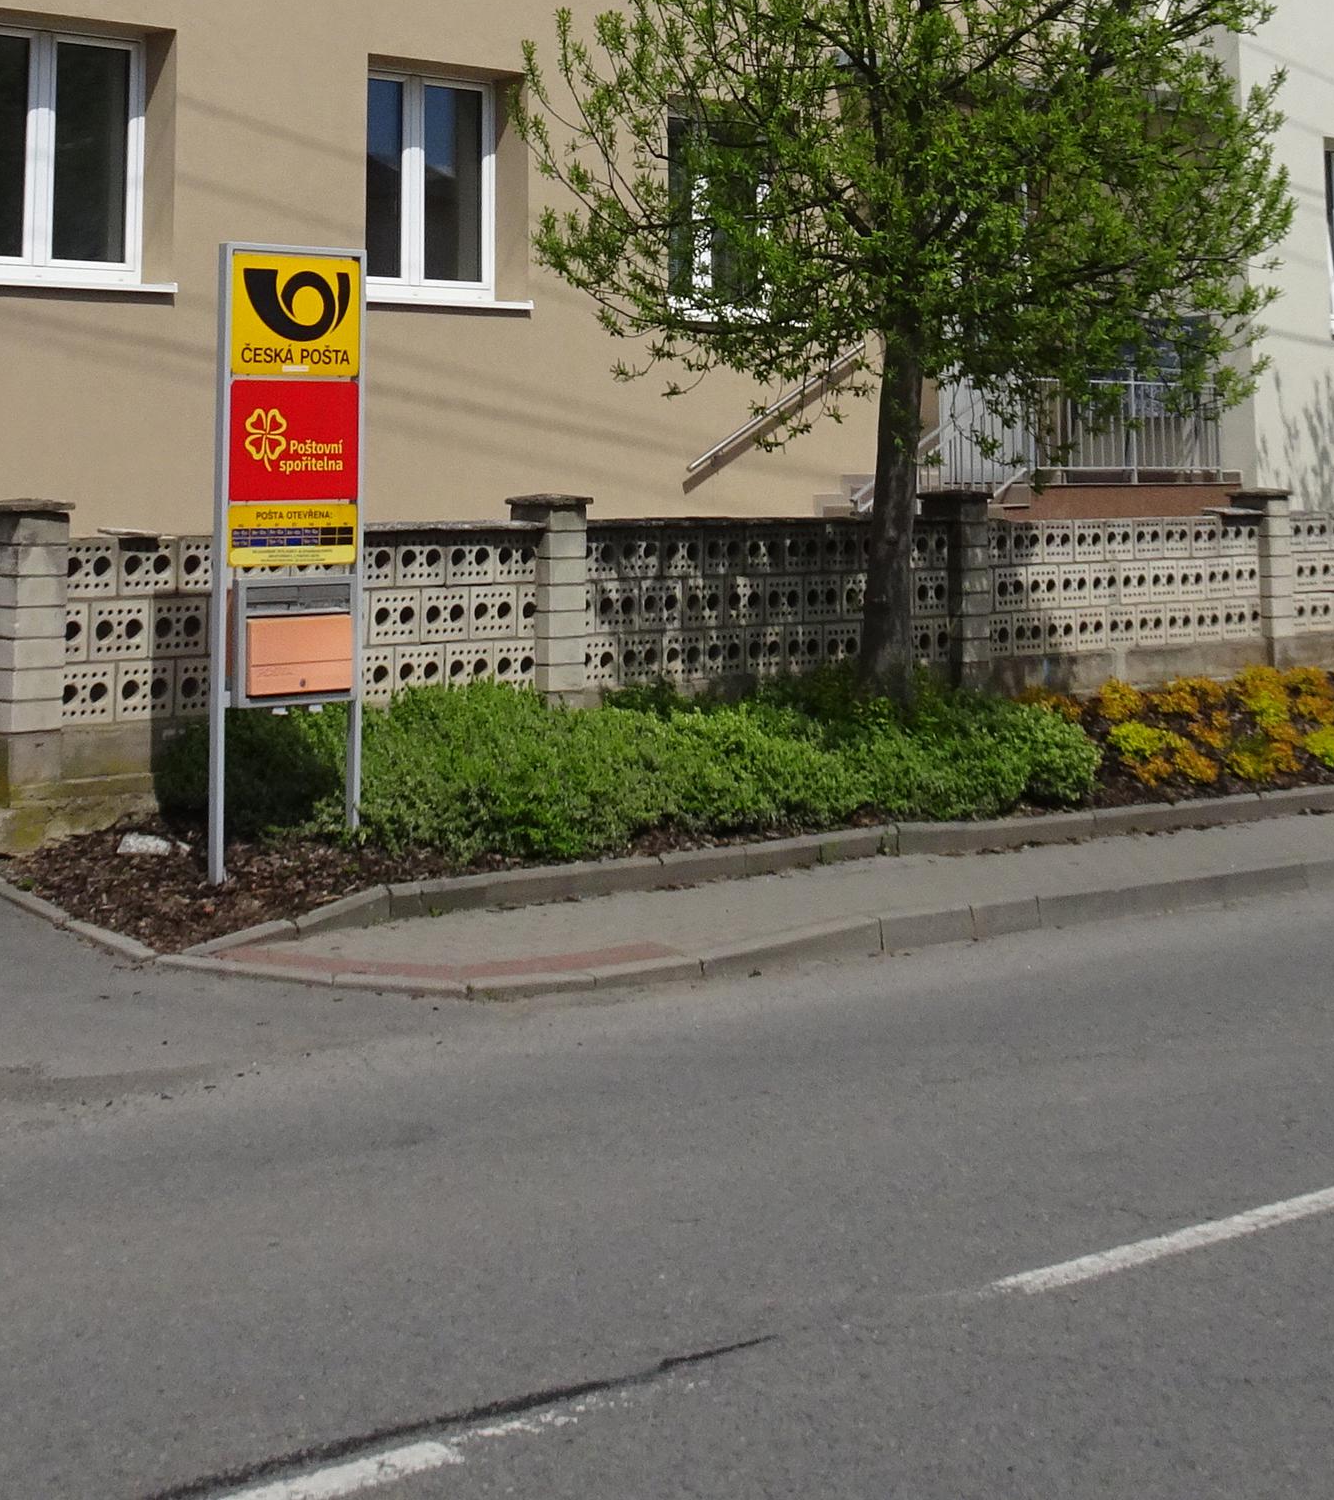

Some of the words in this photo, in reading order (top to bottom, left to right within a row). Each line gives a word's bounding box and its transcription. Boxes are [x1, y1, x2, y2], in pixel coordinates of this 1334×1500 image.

[241, 343, 294, 364] ČESKÁ
[300, 345, 350, 365] POŠTA
[289, 439, 343, 454] Poštovní
[279, 456, 343, 475] spořitelna
[256, 510, 284, 520] POŠTA
